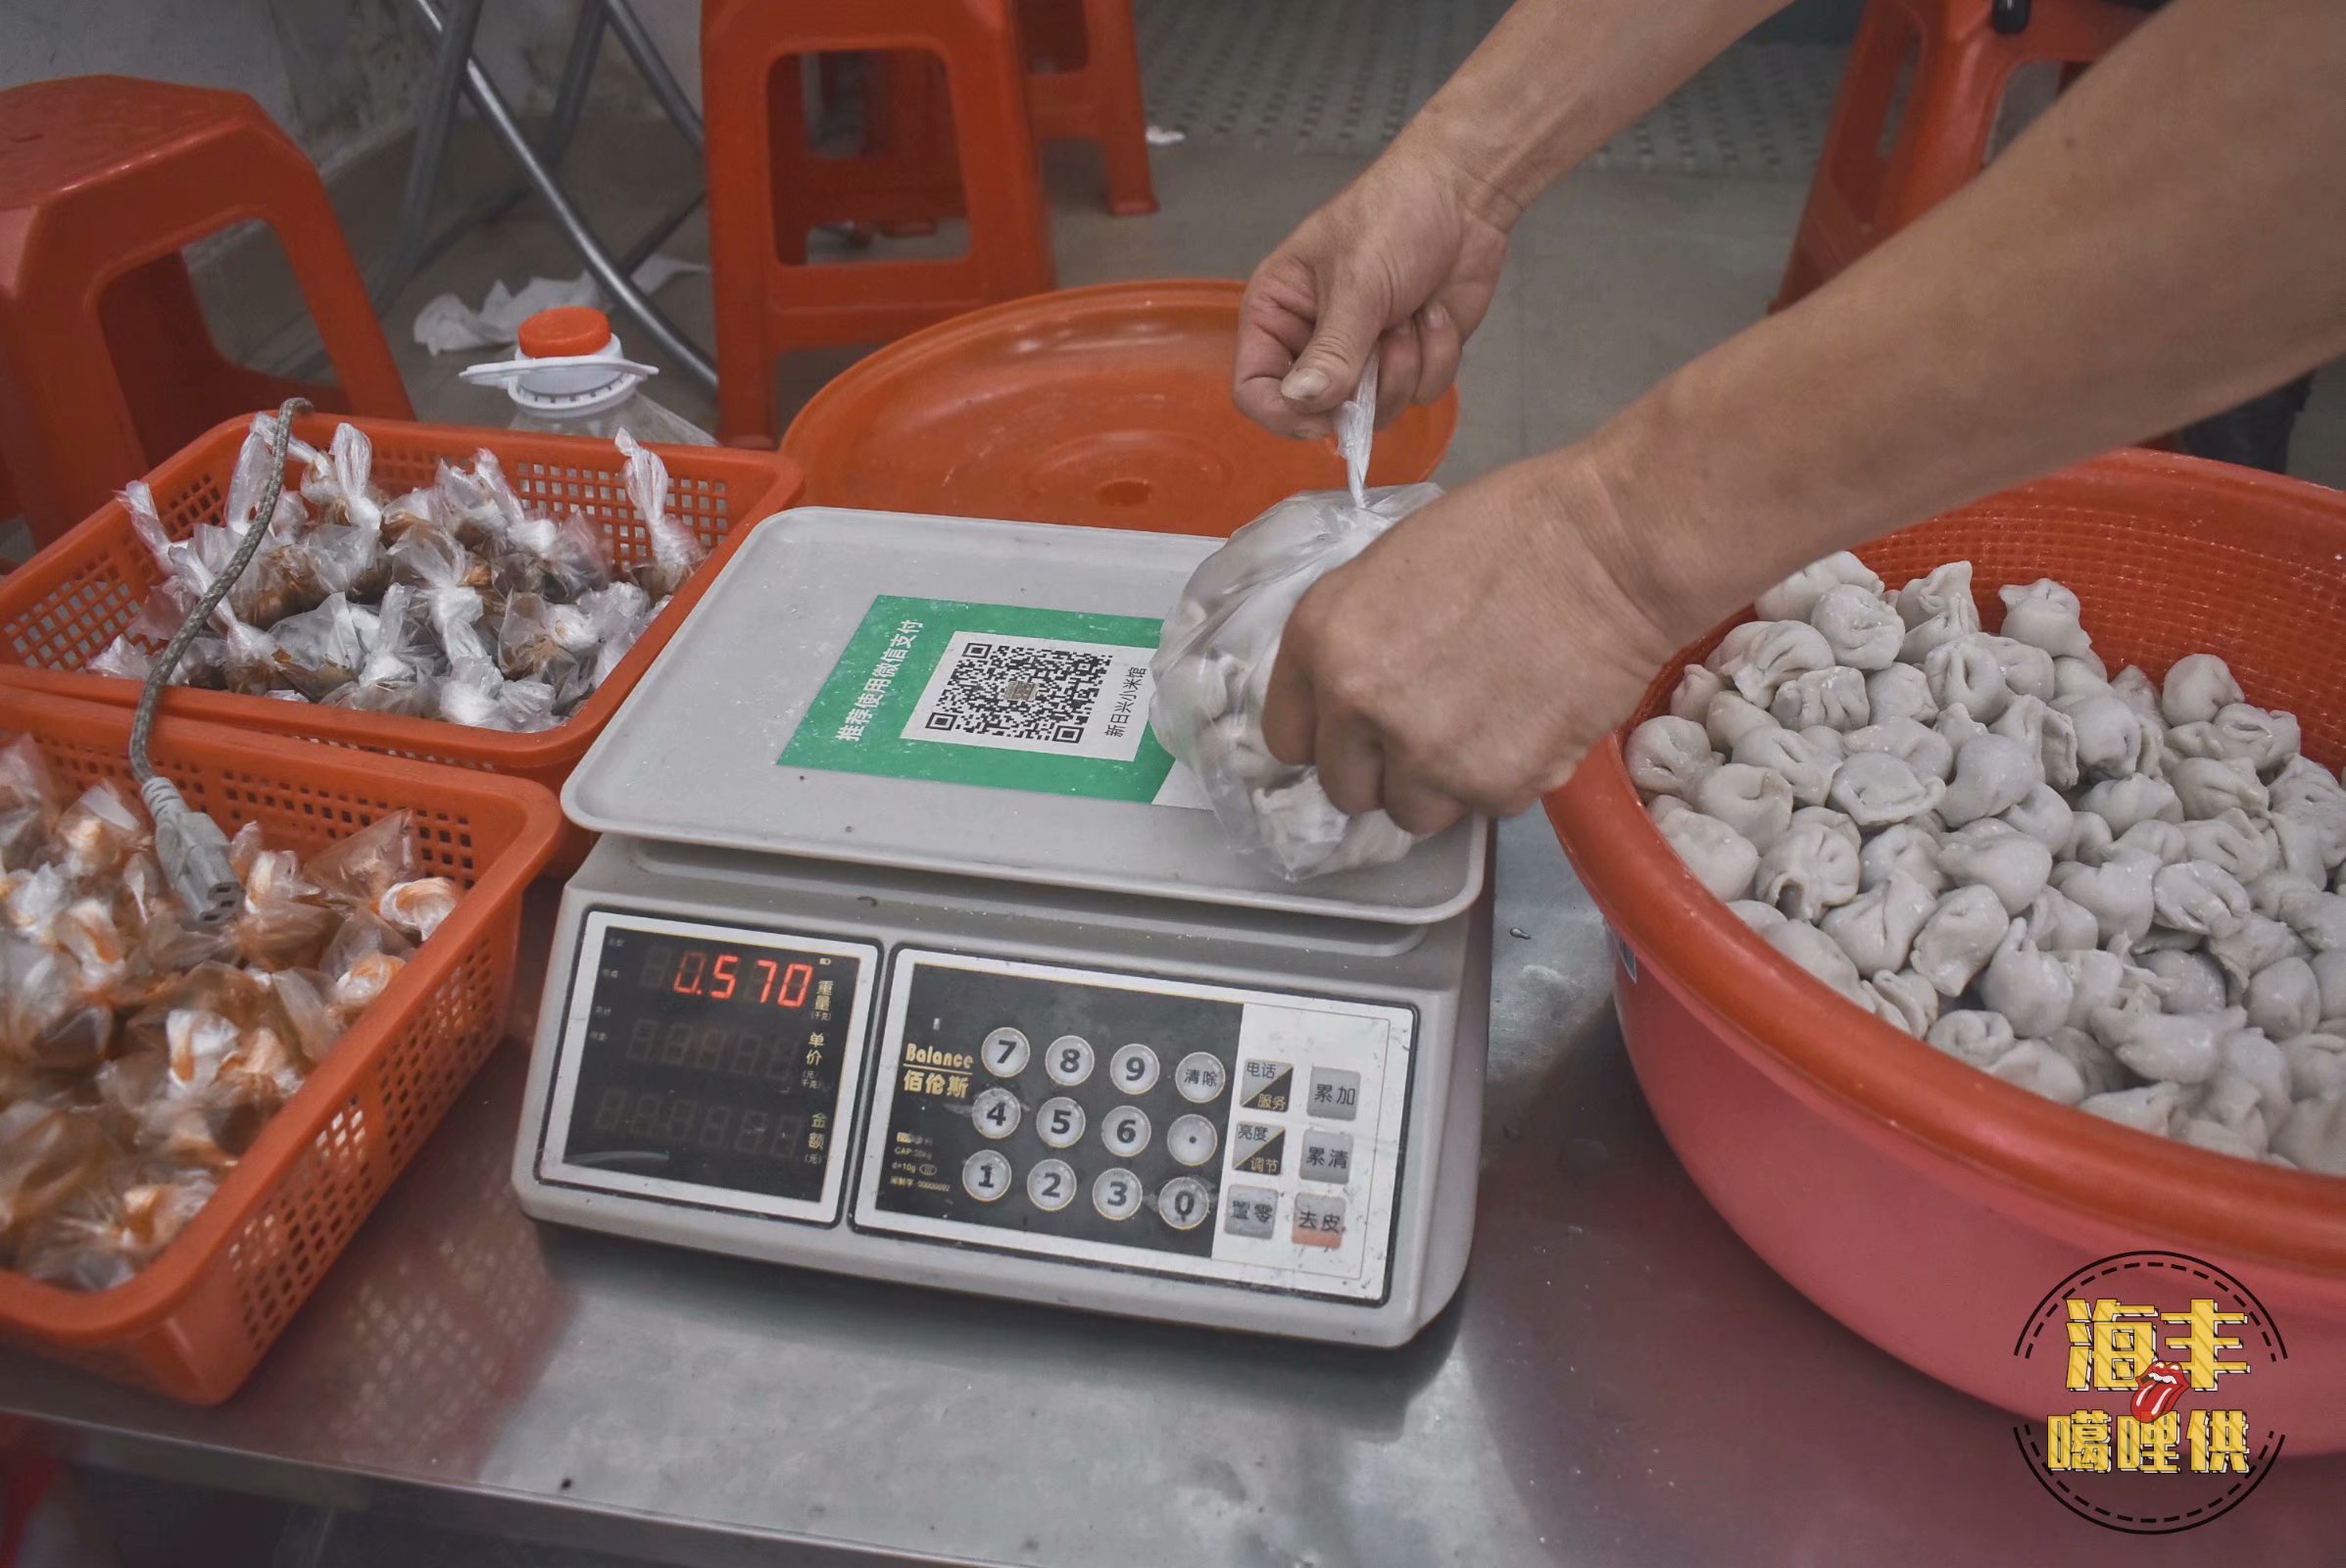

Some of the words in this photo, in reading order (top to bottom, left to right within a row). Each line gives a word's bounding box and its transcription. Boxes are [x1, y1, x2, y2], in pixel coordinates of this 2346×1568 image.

[835, 619, 925, 742] 推荐使用微信支付
[1104, 666, 1148, 738] 新日兴小米馆
[673, 952, 813, 1007] 0.570
[815, 980, 834, 1010] 重量
[806, 1031, 825, 1066] 单价
[906, 1043, 973, 1069] Balance
[997, 1040, 1016, 1064] 7
[1058, 1049, 1081, 1073] 8
[1125, 1056, 1146, 1081] 9
[1184, 1068, 1217, 1087] 清除
[1246, 1061, 1277, 1079] 电话
[904, 1070, 968, 1098] 佰伦斯
[1314, 1084, 1356, 1105] 累加
[986, 1102, 1006, 1126] 4
[1256, 1094, 1286, 1111] 服务
[808, 1112, 827, 1151] 金额
[1051, 1109, 1071, 1134] 5
[1115, 1119, 1137, 1144] 6
[1237, 1124, 1268, 1143] 亮度
[1250, 1157, 1278, 1172] 调节
[1306, 1146, 1348, 1169] 累清
[978, 1164, 994, 1189] 1
[1041, 1173, 1061, 1198] 2
[1107, 1181, 1127, 1206] 3
[1232, 1200, 1273, 1223] 置零
[1298, 1211, 1341, 1234] 去皮
